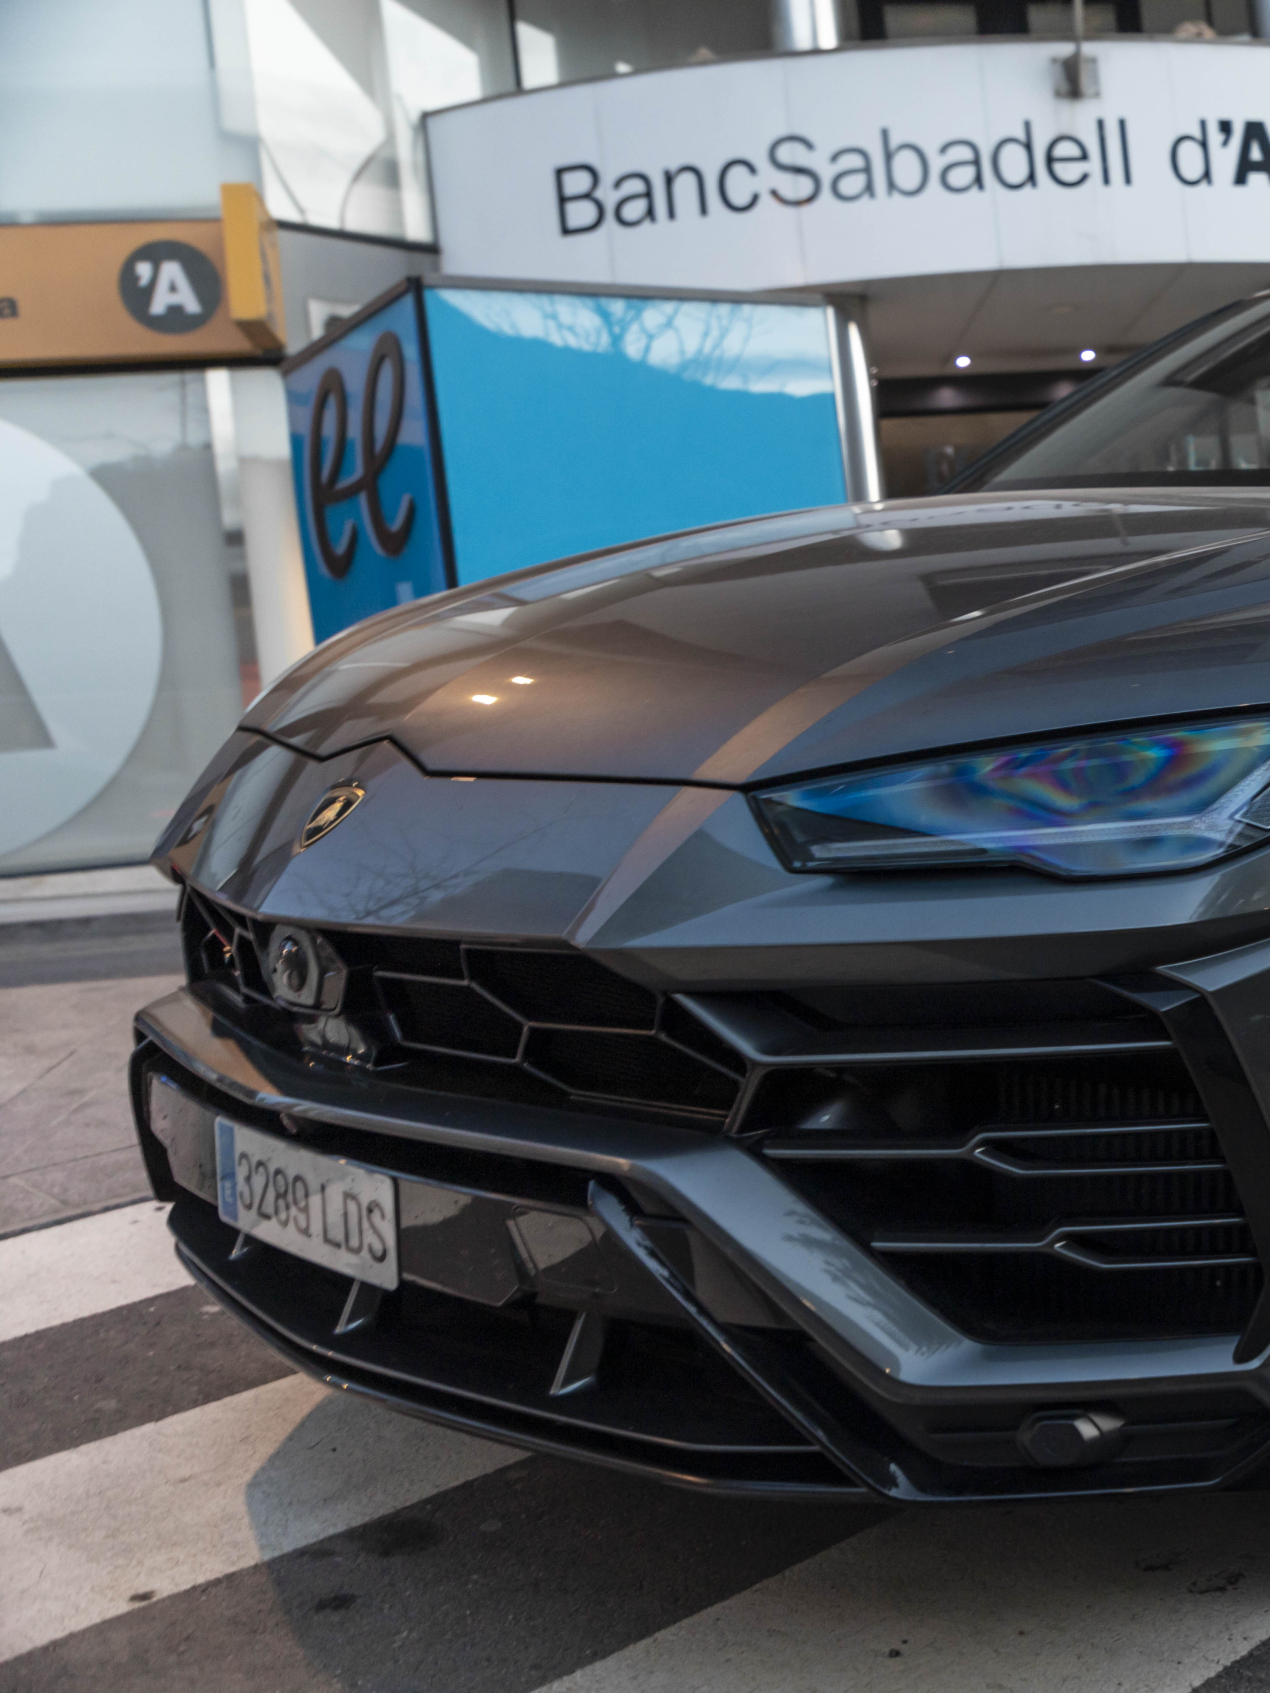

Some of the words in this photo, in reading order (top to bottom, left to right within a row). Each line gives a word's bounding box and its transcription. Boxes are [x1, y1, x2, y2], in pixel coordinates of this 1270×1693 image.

[554, 117, 1132, 237] BancSabadell
[238, 1151, 311, 1238] 3289
[321, 1182, 387, 1263] LDS
